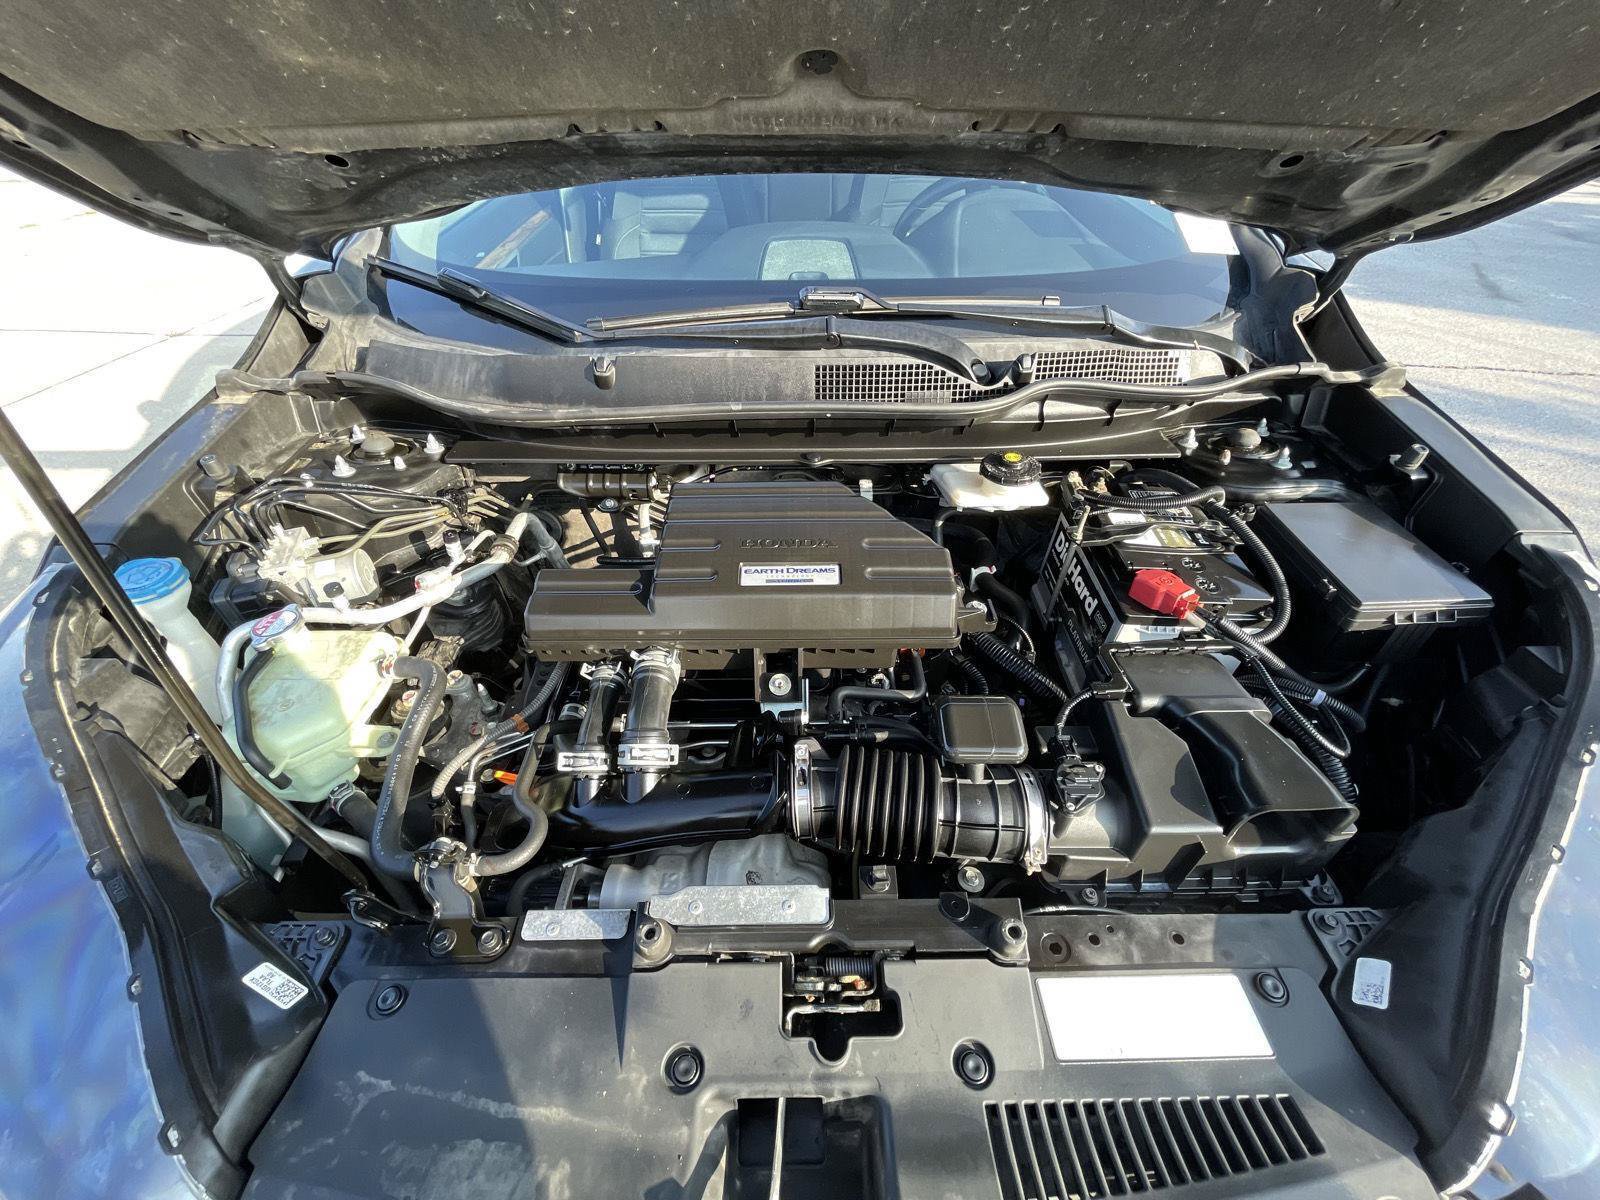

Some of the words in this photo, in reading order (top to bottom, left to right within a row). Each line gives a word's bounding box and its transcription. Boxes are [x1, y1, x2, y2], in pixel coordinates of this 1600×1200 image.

[741, 538, 838, 549] HONDA
[743, 567, 784, 575] EARTH
[1067, 619, 1090, 664] PLATINUM
